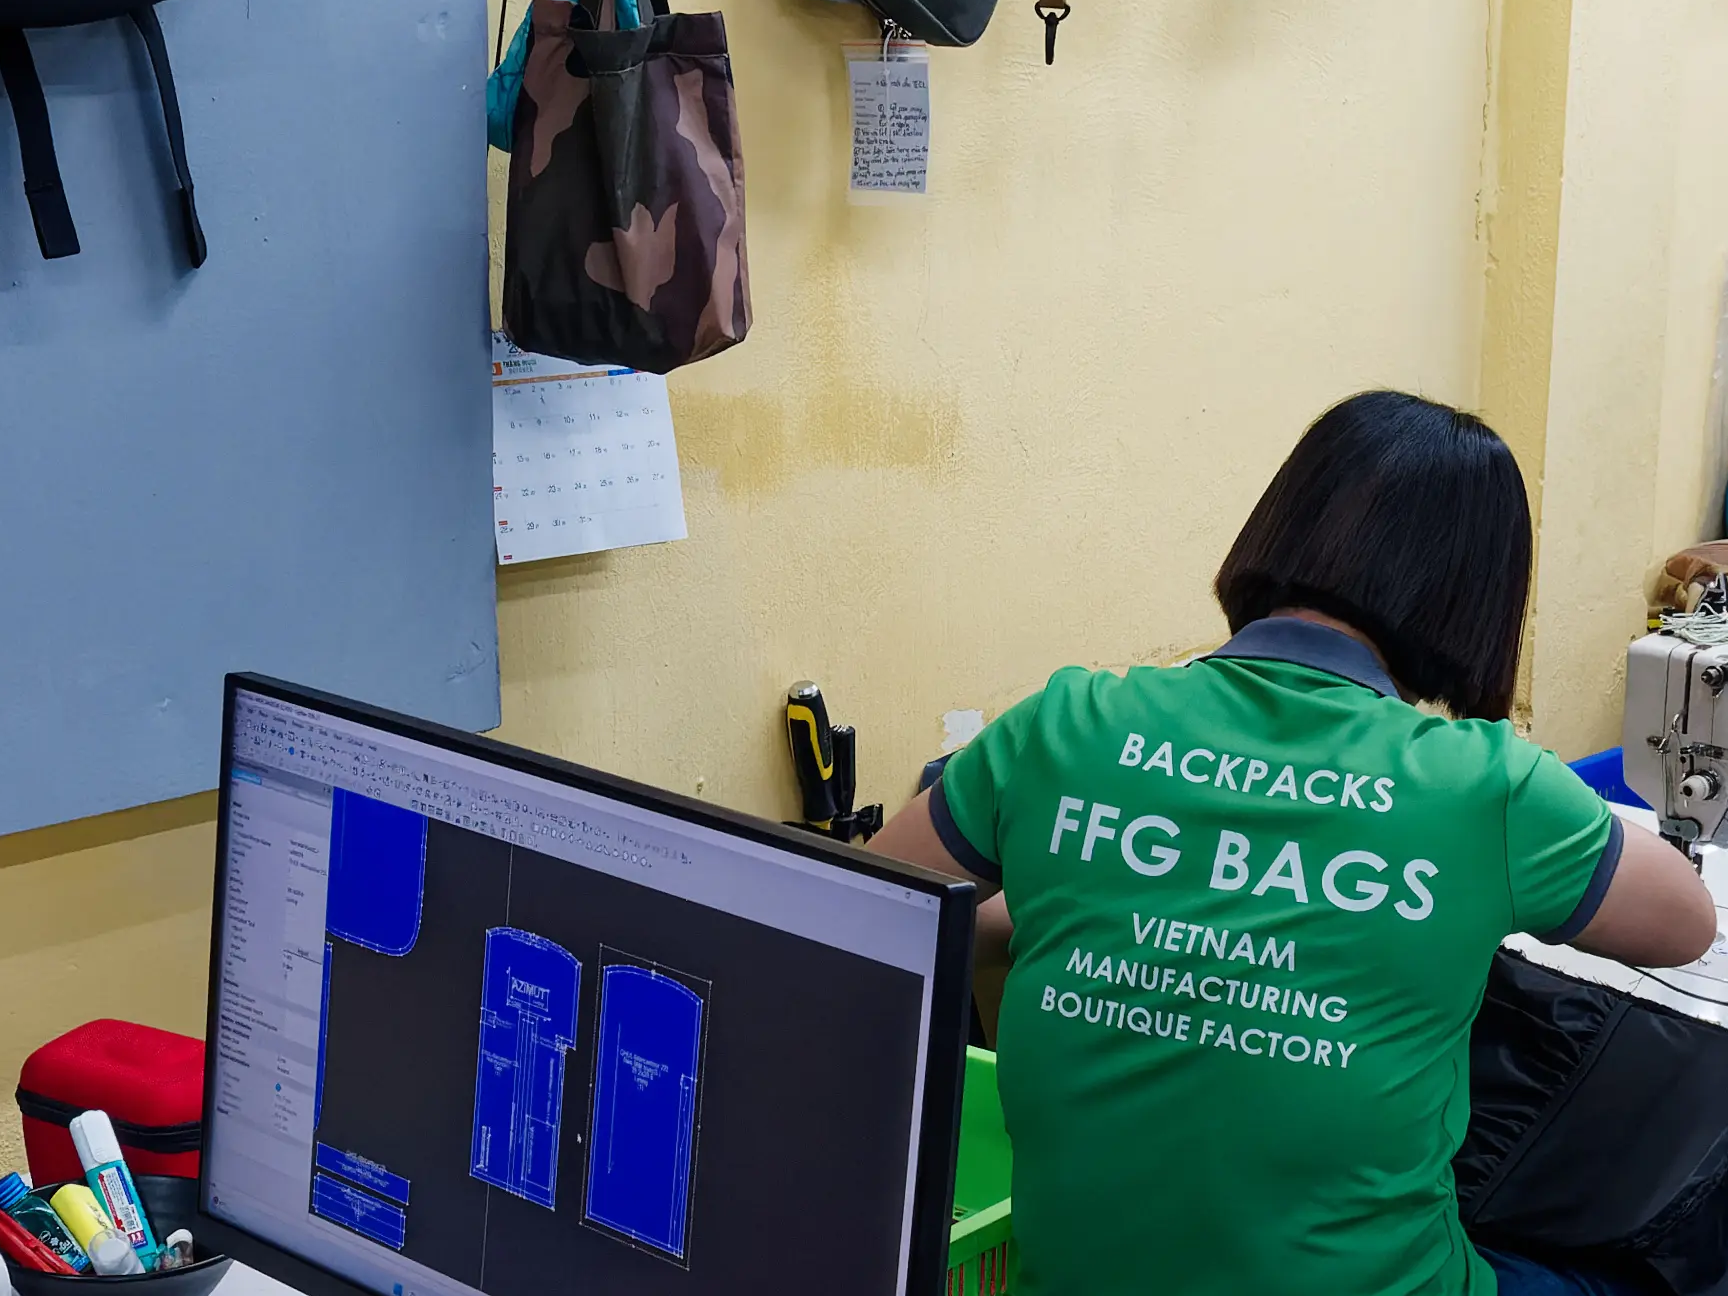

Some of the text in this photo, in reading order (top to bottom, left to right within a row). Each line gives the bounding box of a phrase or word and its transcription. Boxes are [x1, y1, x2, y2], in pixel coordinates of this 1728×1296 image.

[1118, 732, 1395, 812] BACKPACKS
[1048, 795, 1439, 921] FFG BAGS
[1131, 912, 1297, 973] VIETNAM
[1065, 947, 1348, 1024] MANUFACTURING
[1040, 985, 1358, 1069] BOUTIQUE FACTORY
